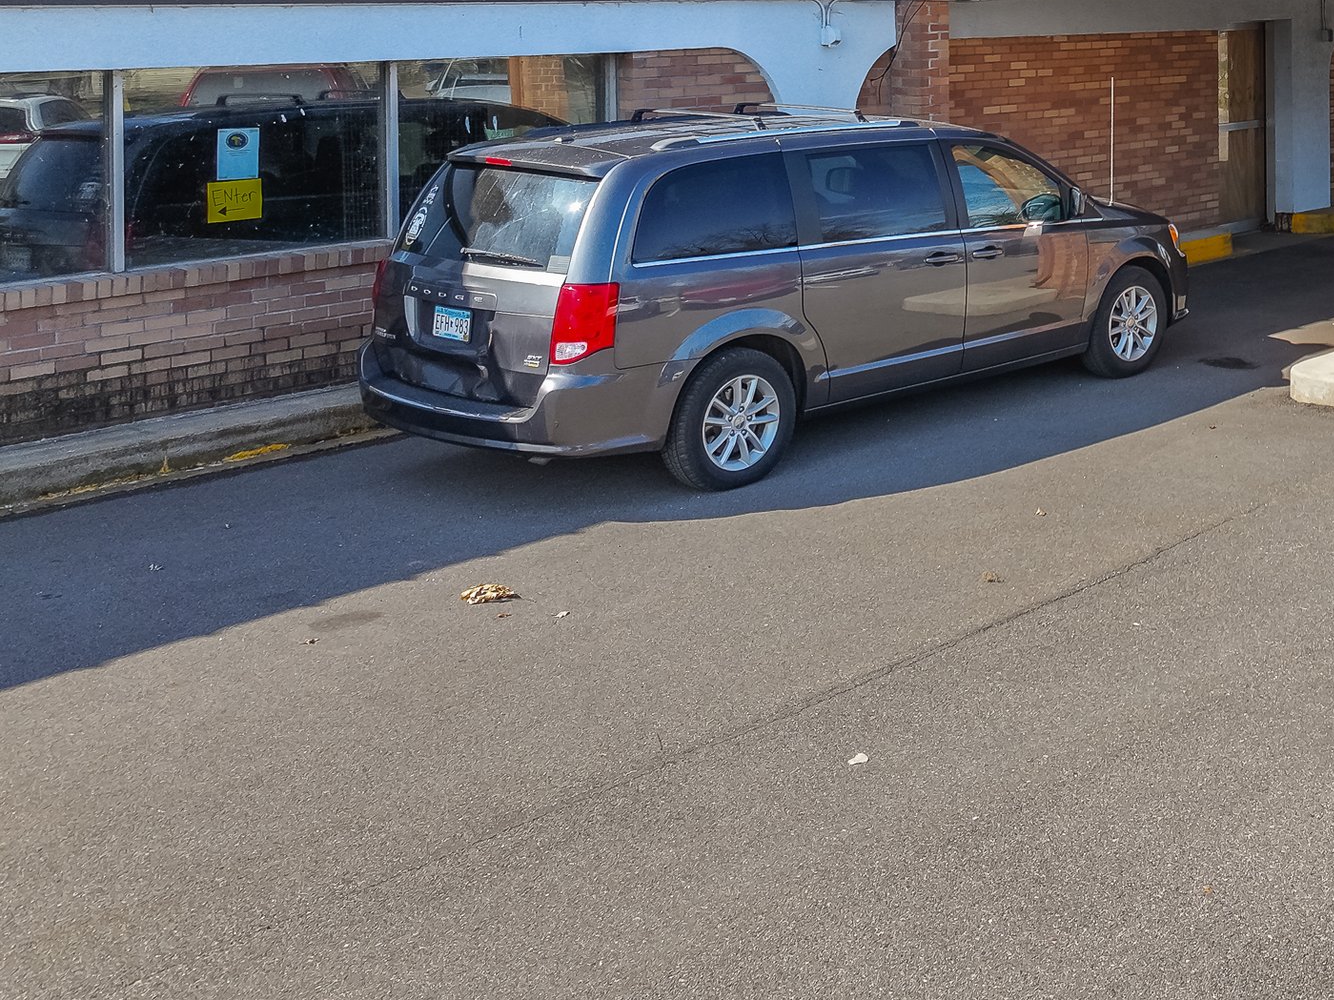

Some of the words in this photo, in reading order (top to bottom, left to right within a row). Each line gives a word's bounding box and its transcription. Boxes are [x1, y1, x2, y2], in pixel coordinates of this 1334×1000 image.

[212, 187, 257, 207] ENter
[410, 285, 483, 303] DODGE
[435, 313, 450, 332] EFH
[454, 317, 469, 336] 983
